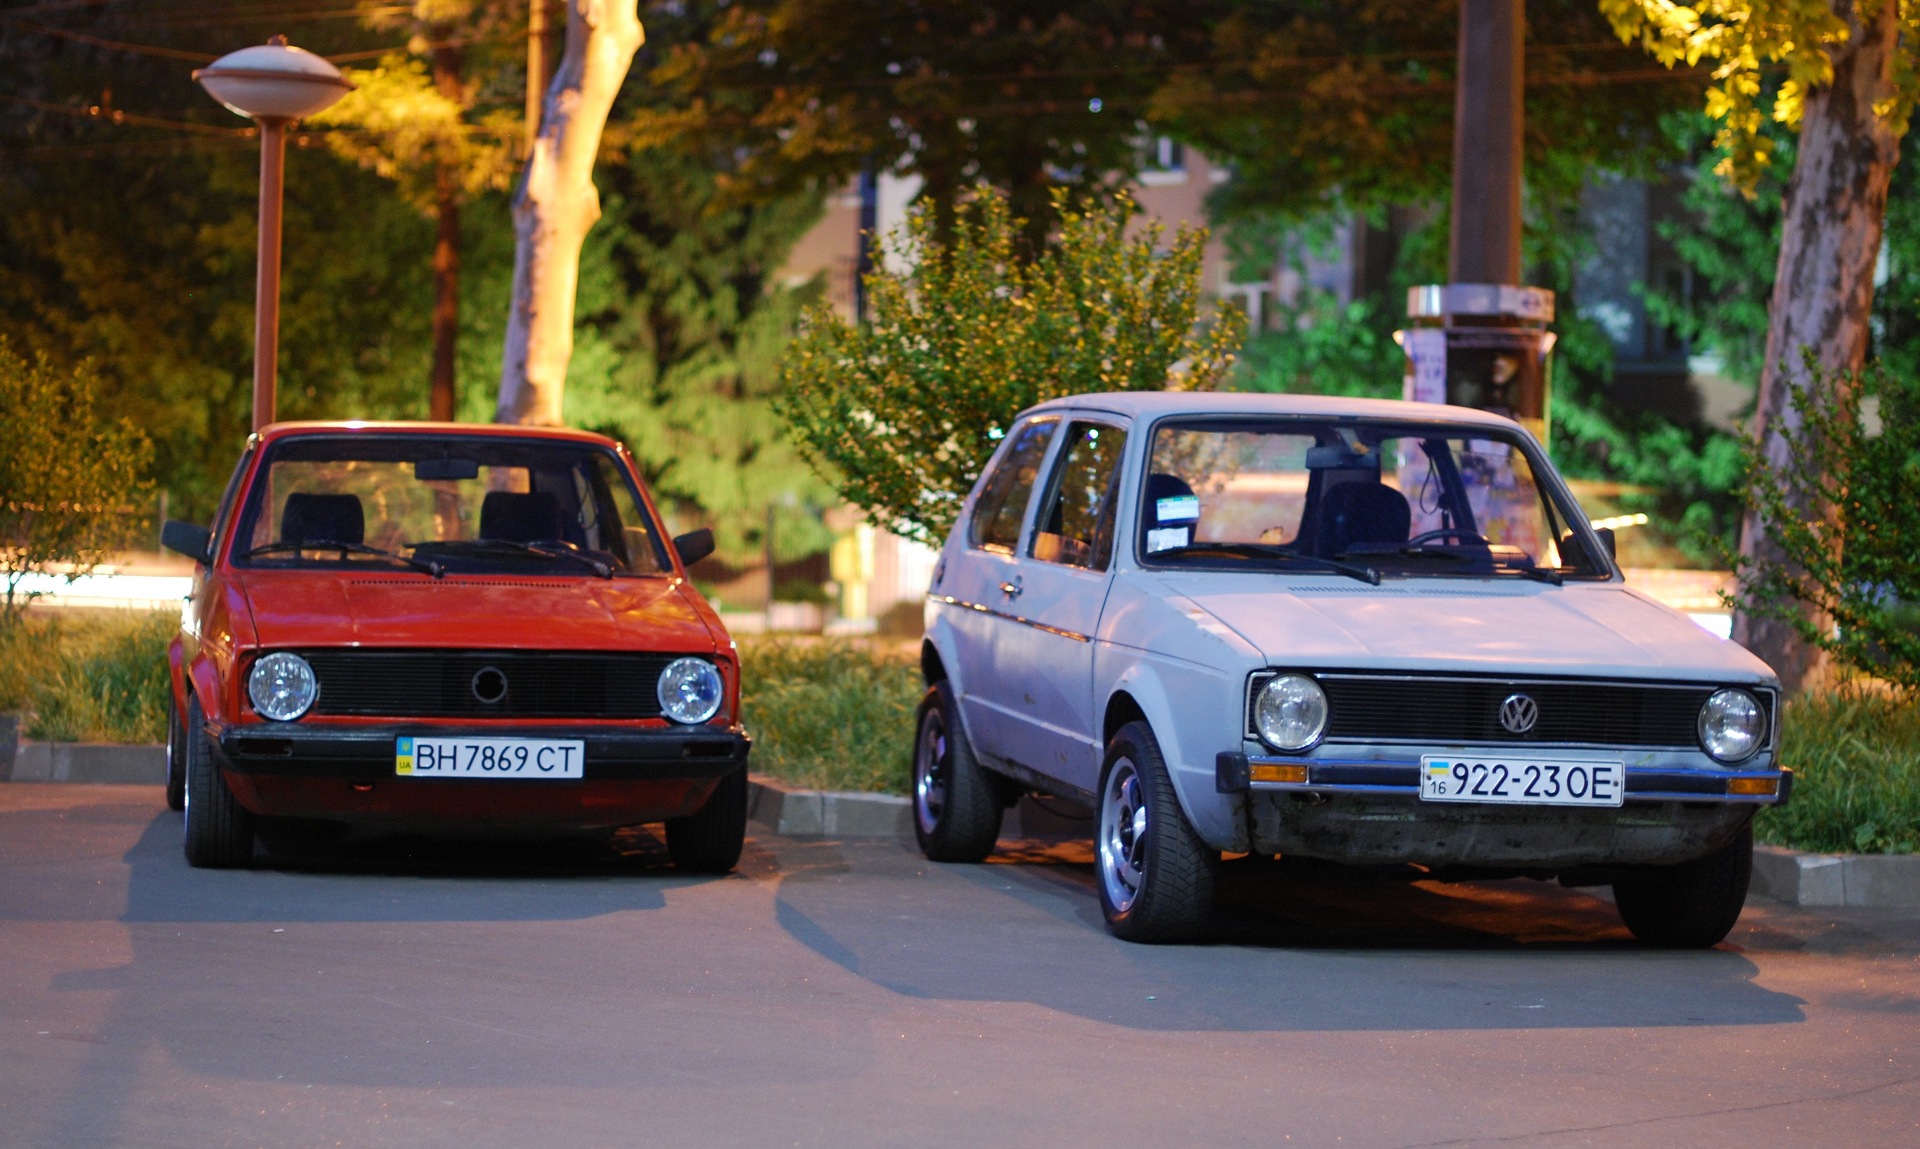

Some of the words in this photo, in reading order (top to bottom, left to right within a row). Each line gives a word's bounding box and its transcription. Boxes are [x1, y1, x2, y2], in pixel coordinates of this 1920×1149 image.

[1501, 694, 1538, 733] VW
[399, 761, 411, 769] UA
[416, 744, 457, 770] BH
[465, 745, 529, 771] 7869
[536, 746, 577, 772] CT
[1430, 781, 1446, 794] 16
